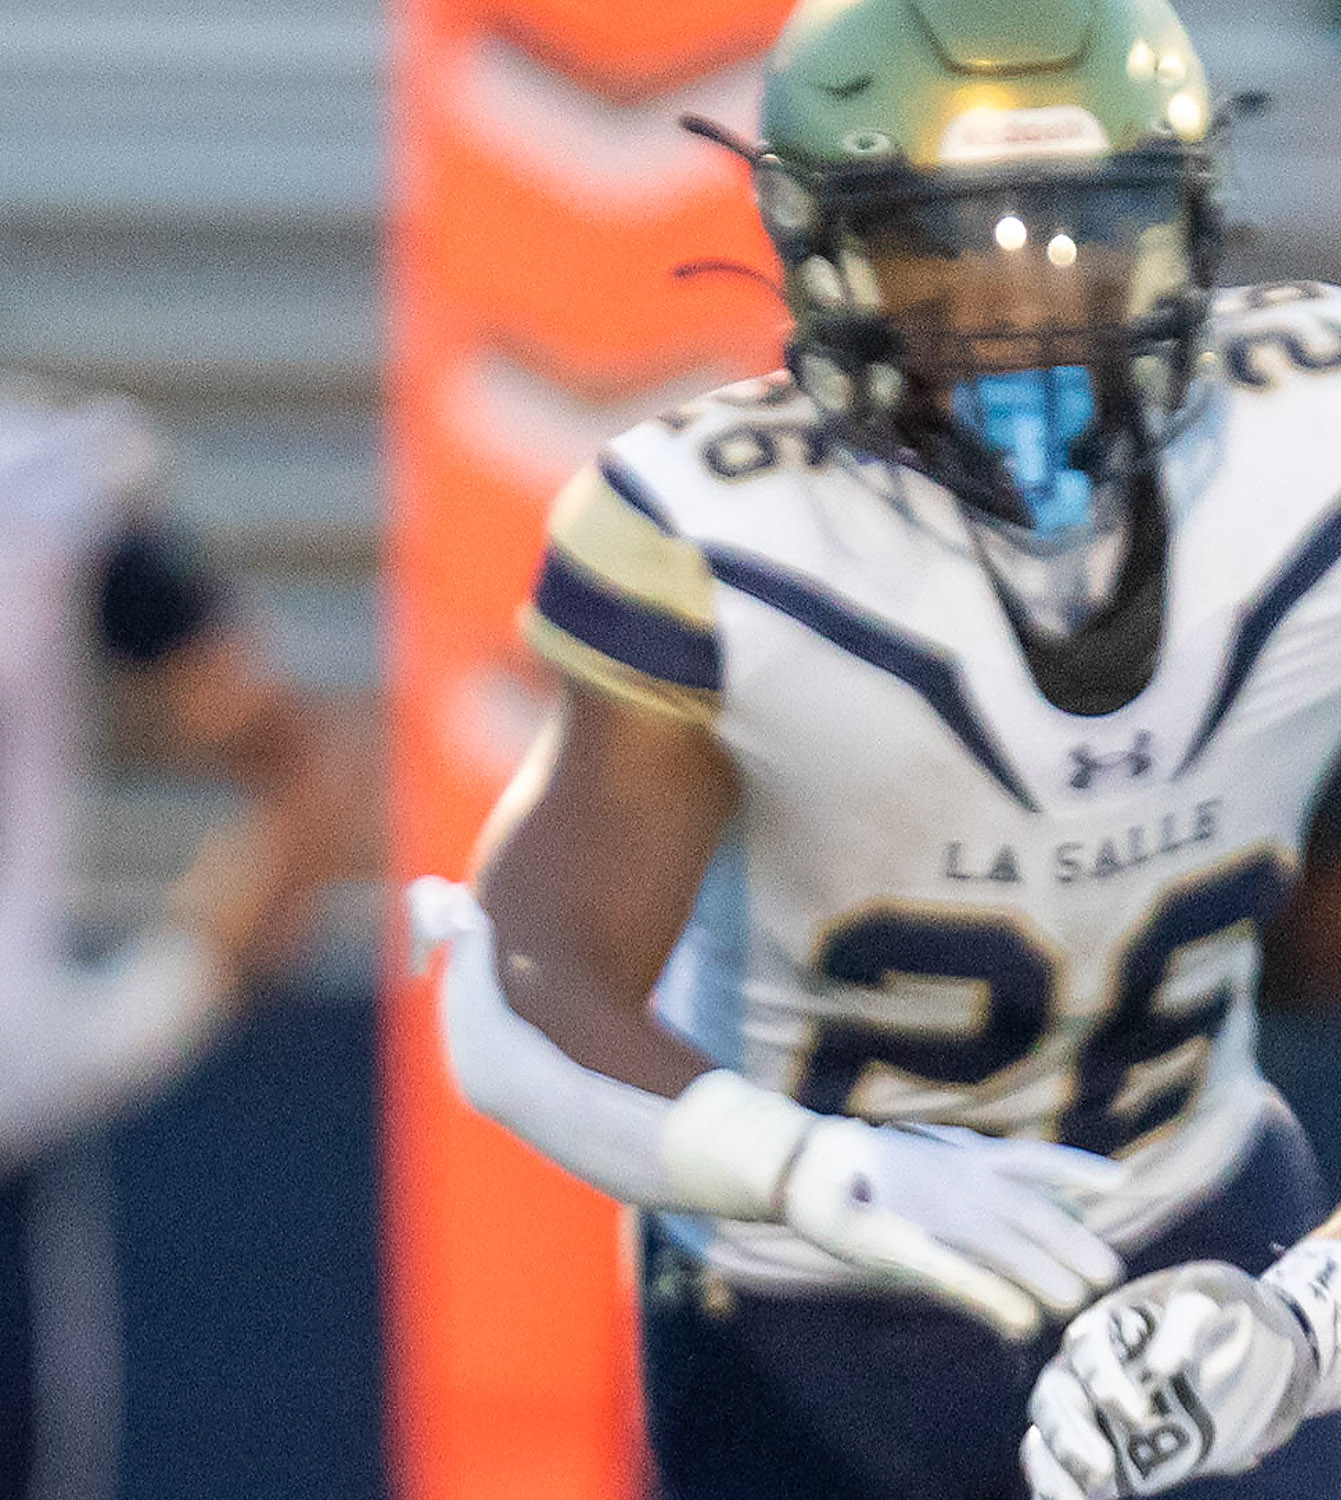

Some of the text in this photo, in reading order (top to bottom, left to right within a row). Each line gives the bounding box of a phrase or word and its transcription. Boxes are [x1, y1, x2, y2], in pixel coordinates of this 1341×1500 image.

[944, 800, 1222, 884] LA SALLE
[797, 838, 1299, 1160] 26
